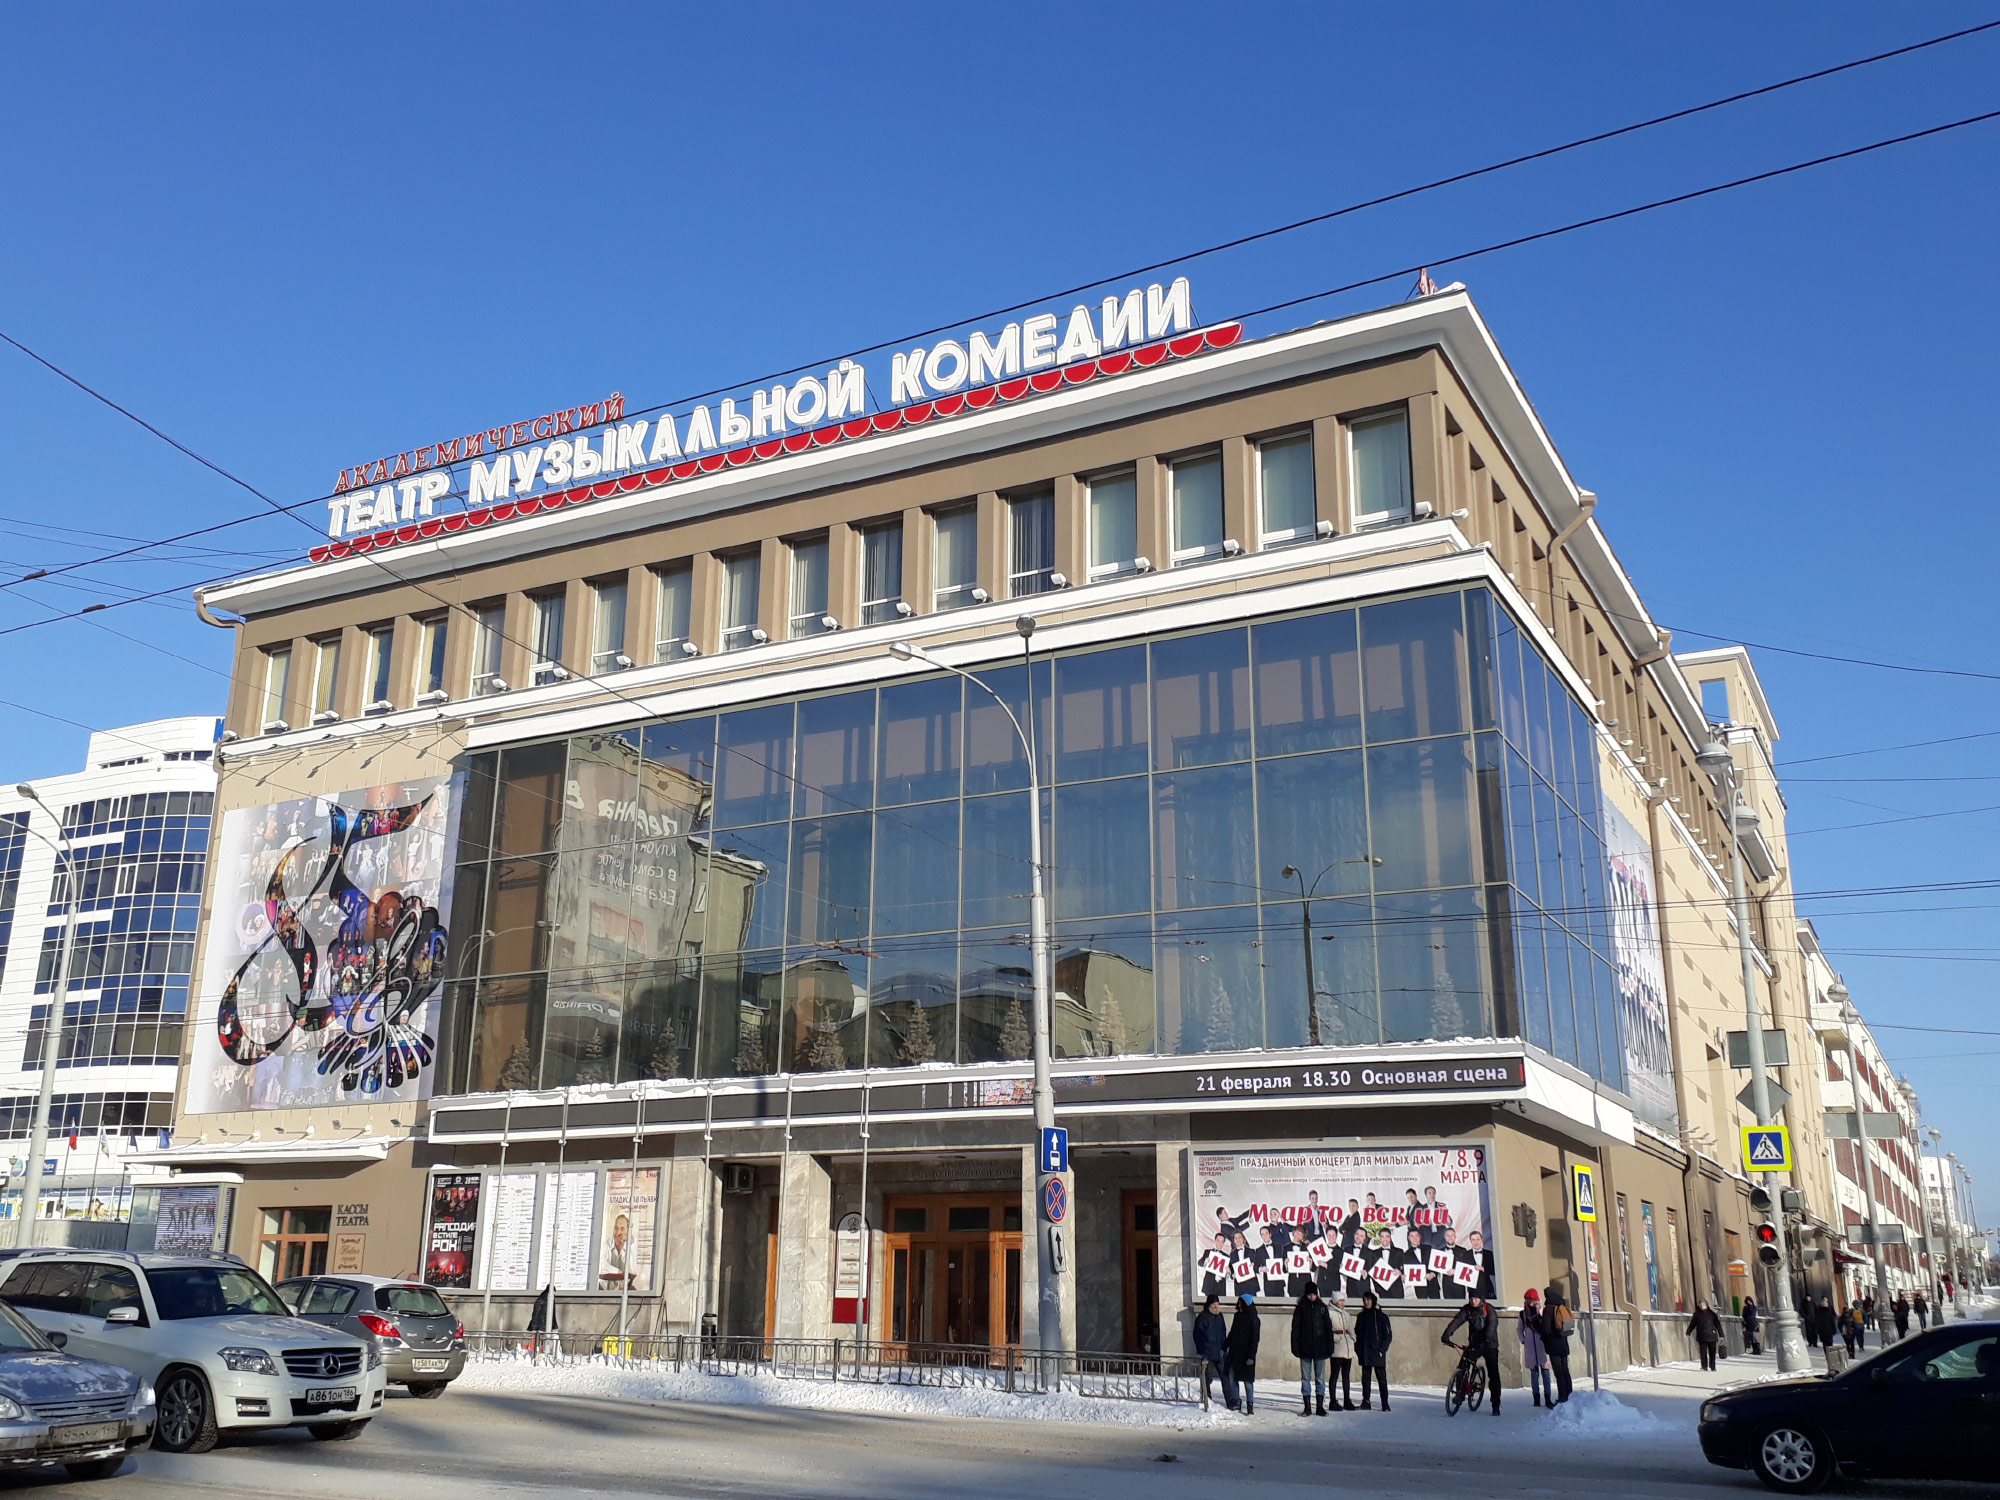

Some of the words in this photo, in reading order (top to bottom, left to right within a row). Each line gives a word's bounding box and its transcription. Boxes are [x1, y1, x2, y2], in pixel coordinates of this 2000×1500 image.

[328, 471, 451, 538] ТЕАТР
[468, 360, 866, 506] МУЗЫКАЛЬНОЙ
[891, 276, 1191, 404] КОМЕДИИ
[334, 391, 625, 493] АКАДЕМИЧЕСКИЙ
[1196, 1075, 1216, 1092] 21
[1221, 1075, 1292, 1094] февраля
[1302, 1070, 1351, 1087] 18.30
[1361, 1068, 1448, 1085] Основная
[1453, 1067, 1508, 1084] сцена
[1240, 1155, 1306, 1168] ПРАЗДНИЧНЫЙ
[1309, 1156, 1350, 1168] КОНЦЕРТ
[1353, 1156, 1372, 1166] ДЛЯ
[1374, 1156, 1409, 1166] МИЛЫХ
[1412, 1155, 1434, 1166] ДАМ
[1440, 1170, 1487, 1184] МАРТА
[337, 1203, 369, 1215] КАССЫ
[336, 1215, 370, 1227] ТЕАТРА
[431, 1239, 458, 1252] РОК
